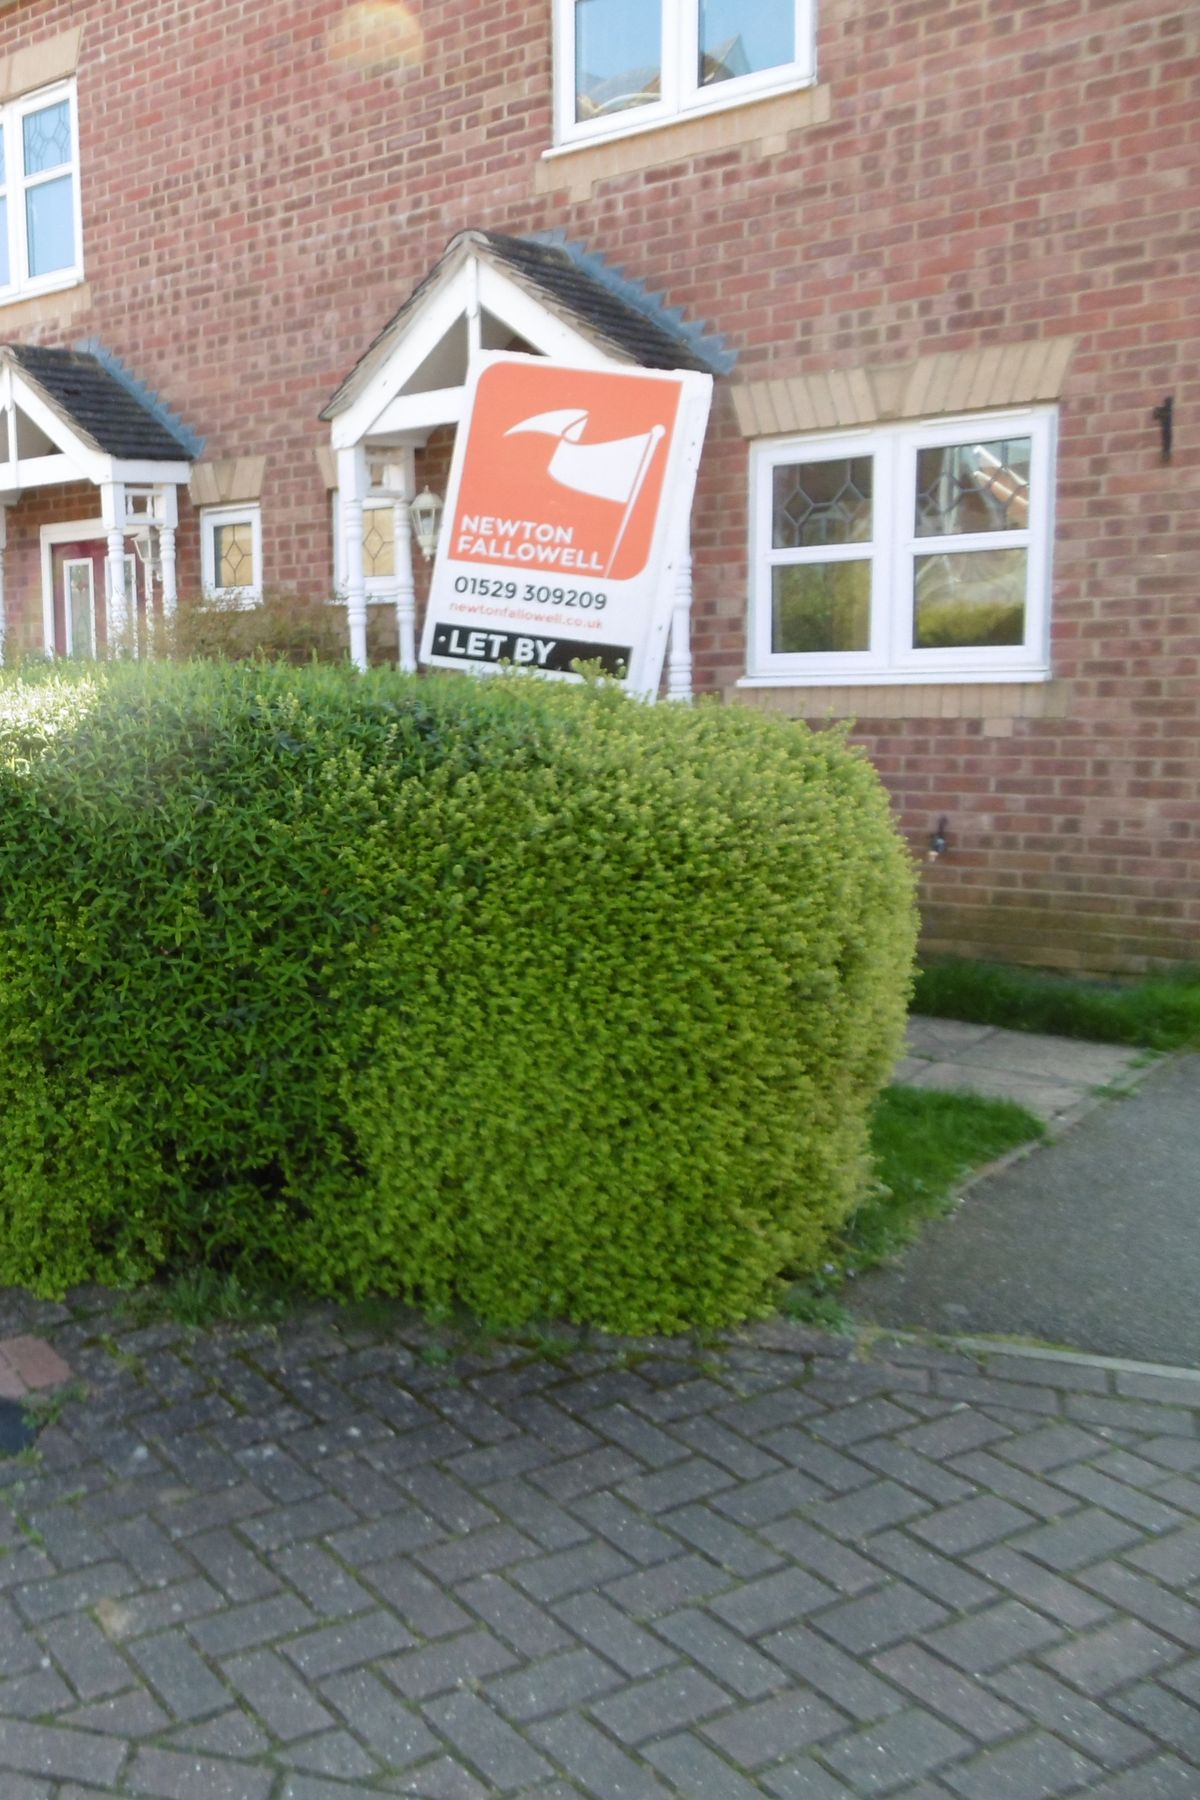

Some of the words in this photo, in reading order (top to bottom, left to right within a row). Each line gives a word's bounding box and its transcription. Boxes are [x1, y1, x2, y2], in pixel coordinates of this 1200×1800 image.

[461, 514, 573, 544] NEWTON
[457, 536, 604, 570] FALLOWELL
[454, 576, 517, 599] 01529
[523, 585, 607, 610] 309209
[449, 602, 603, 629] newtonfallowell.co.uk
[449, 630, 508, 658] LET
[514, 638, 556, 664] BY
